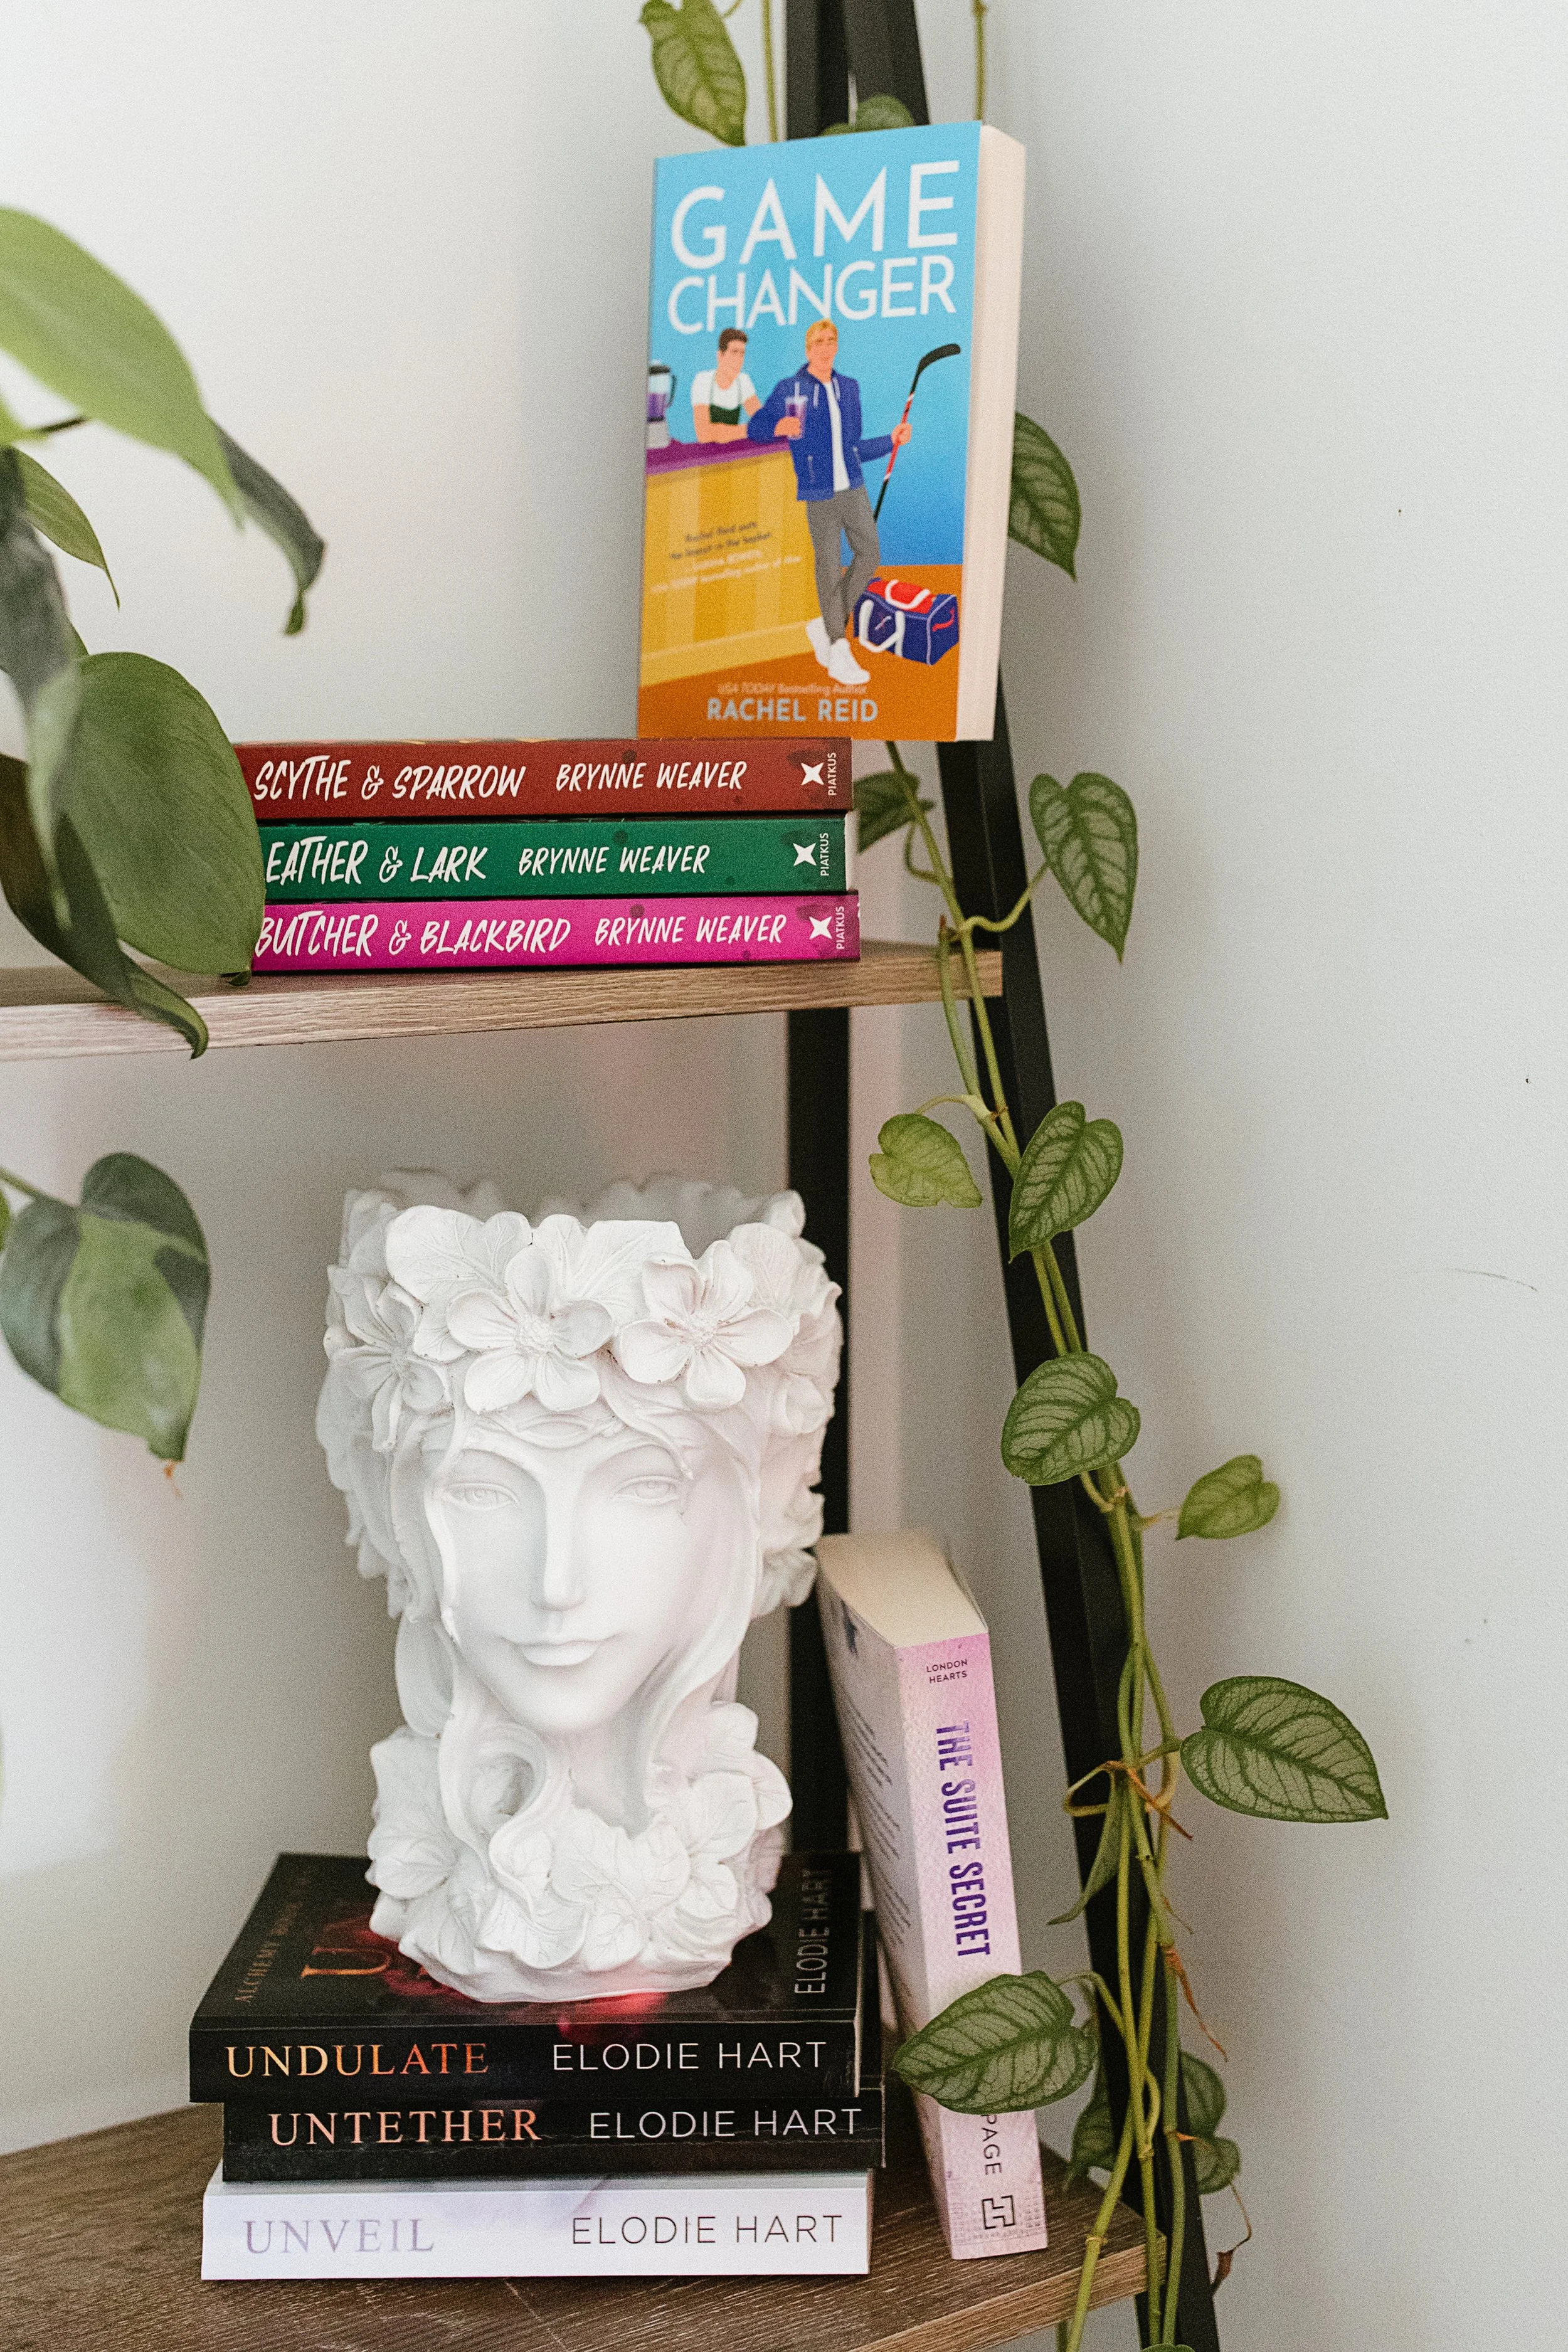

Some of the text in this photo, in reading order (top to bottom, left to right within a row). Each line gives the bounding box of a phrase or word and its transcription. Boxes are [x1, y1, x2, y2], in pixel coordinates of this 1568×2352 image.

[671, 160, 960, 270] GAME
[668, 255, 956, 334] CHANGER
[707, 697, 878, 723] RACHEL REID
[255, 755, 526, 800] SCYTHE & SPARROW
[556, 761, 747, 791] BRYNNE WEAVER
[827, 752, 837, 796] PIATKUS
[267, 835, 488, 885] EATHER & LARK
[518, 844, 710, 876] BRYNNE WEAVER
[819, 832, 829, 877] PIATKUS
[255, 910, 571, 956] BUTCHER & BLACKBIRD
[595, 914, 787, 945] BRYNNE WEAVER
[835, 906, 845, 950] PIATKUS
[926, 1658, 968, 1673] LONDON
[929, 1670, 968, 1683] HEARTS
[936, 1720, 990, 1956] THE SUITE SECRET
[794, 1927, 829, 1993] ELODIE
[226, 2042, 489, 2078] UNDULATE
[553, 2042, 825, 2071] ELODIE HART
[269, 2109, 543, 2146] UNTETHER
[590, 2108, 861, 2139] ELODIE HART
[981, 2114, 1002, 2175] PAGE
[243, 2218, 434, 2255] UNVEIL
[572, 2214, 842, 2245] ELODIE HART
